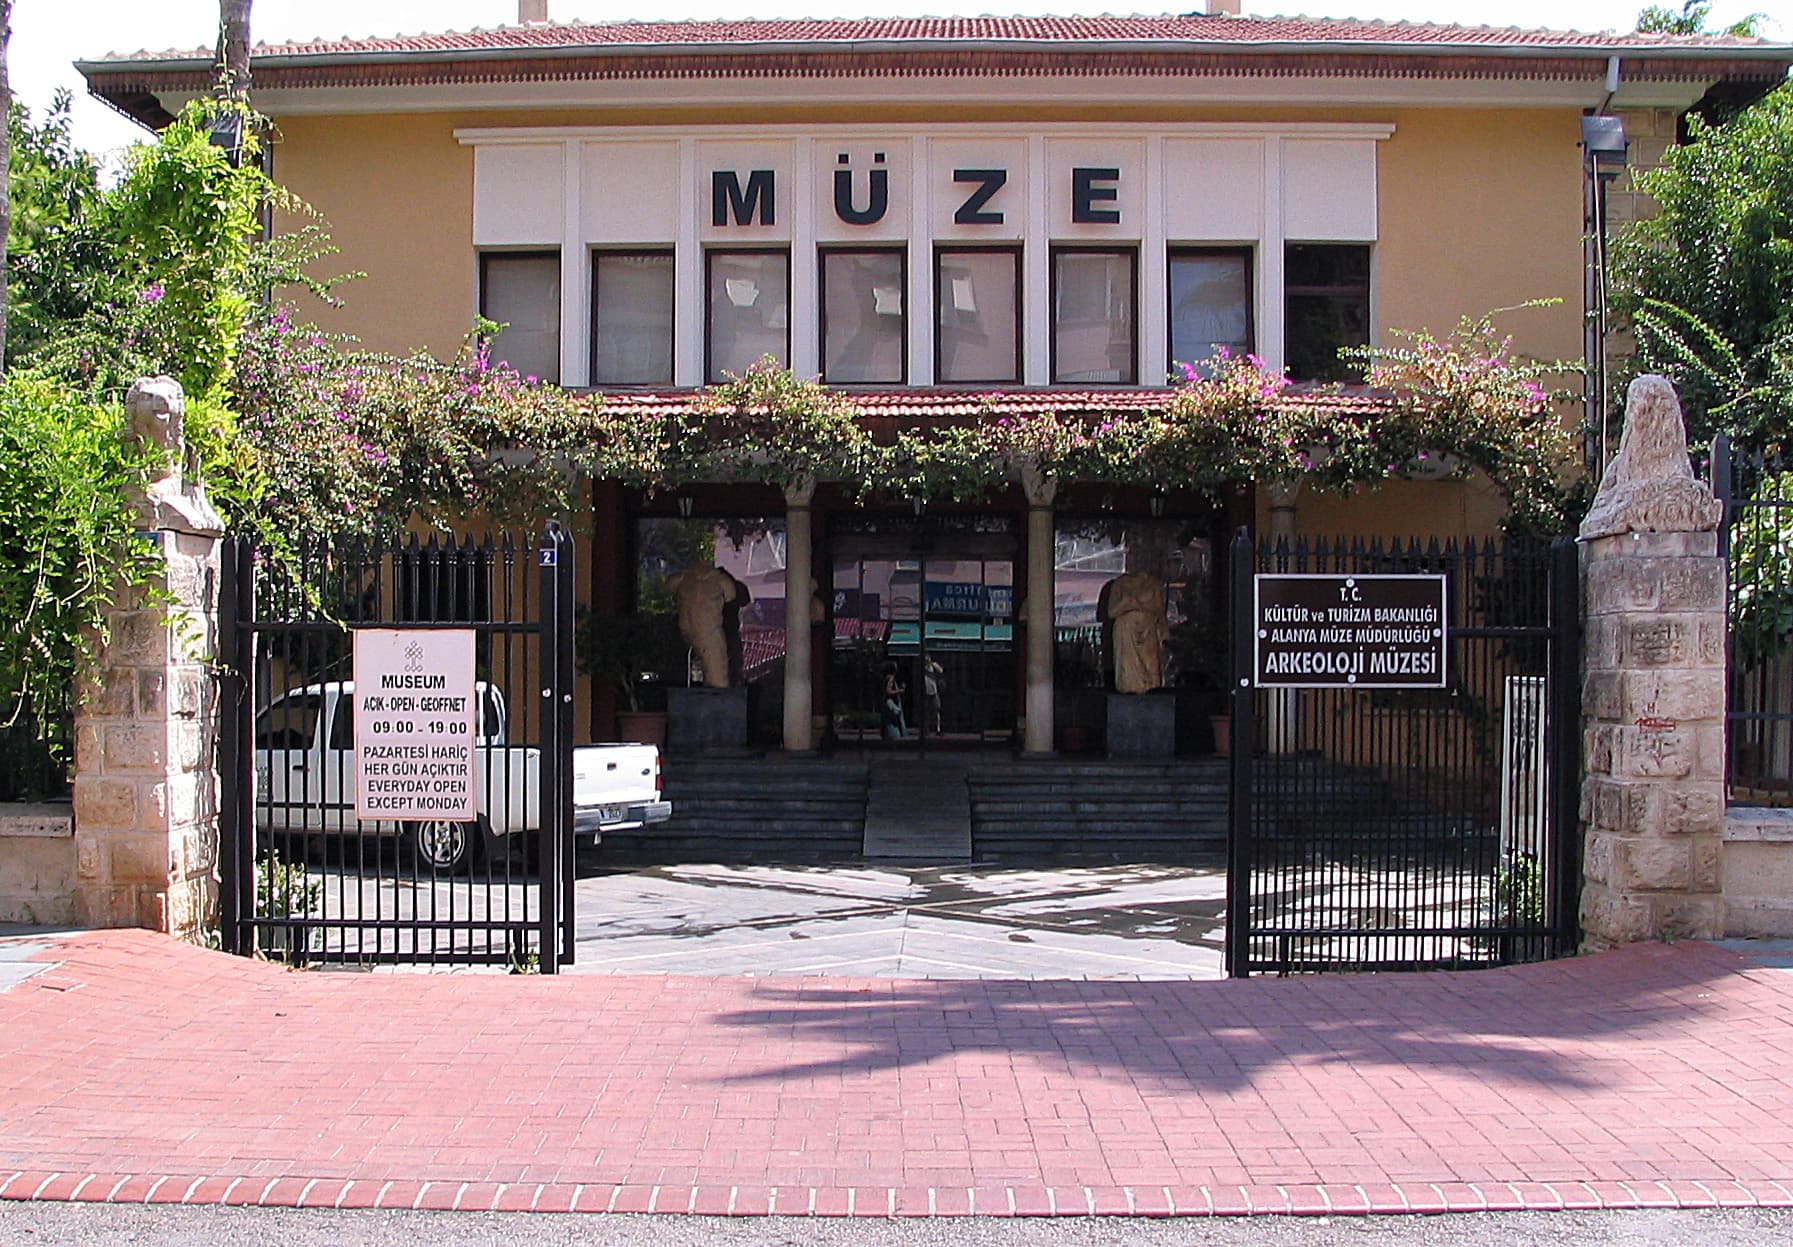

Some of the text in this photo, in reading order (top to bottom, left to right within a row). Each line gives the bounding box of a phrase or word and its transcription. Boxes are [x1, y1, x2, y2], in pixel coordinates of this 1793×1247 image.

[712, 152, 1121, 227] MÜZE
[543, 551, 551, 563] 2
[1264, 604, 1437, 622] KÜLTÜR ve TURİZM BAKANLIĞI
[1271, 624, 1431, 643] ALANYA MÜZE MÜDÜRLÜĞÜ
[1265, 645, 1436, 674] ARKEOLOJİ MÜZESİ
[381, 675, 446, 689] MUSEUM
[390, 696, 415, 712] OPEN
[373, 721, 413, 733] 09:00
[428, 721, 467, 734] 19:00
[363, 744, 468, 762] PAZARTESİ HARİÇ
[364, 761, 467, 778] HER GÜN AÇIKTIR
[368, 780, 466, 793] EVERYDAY OPEN
[367, 796, 467, 809] EXCEPT MONDAY
